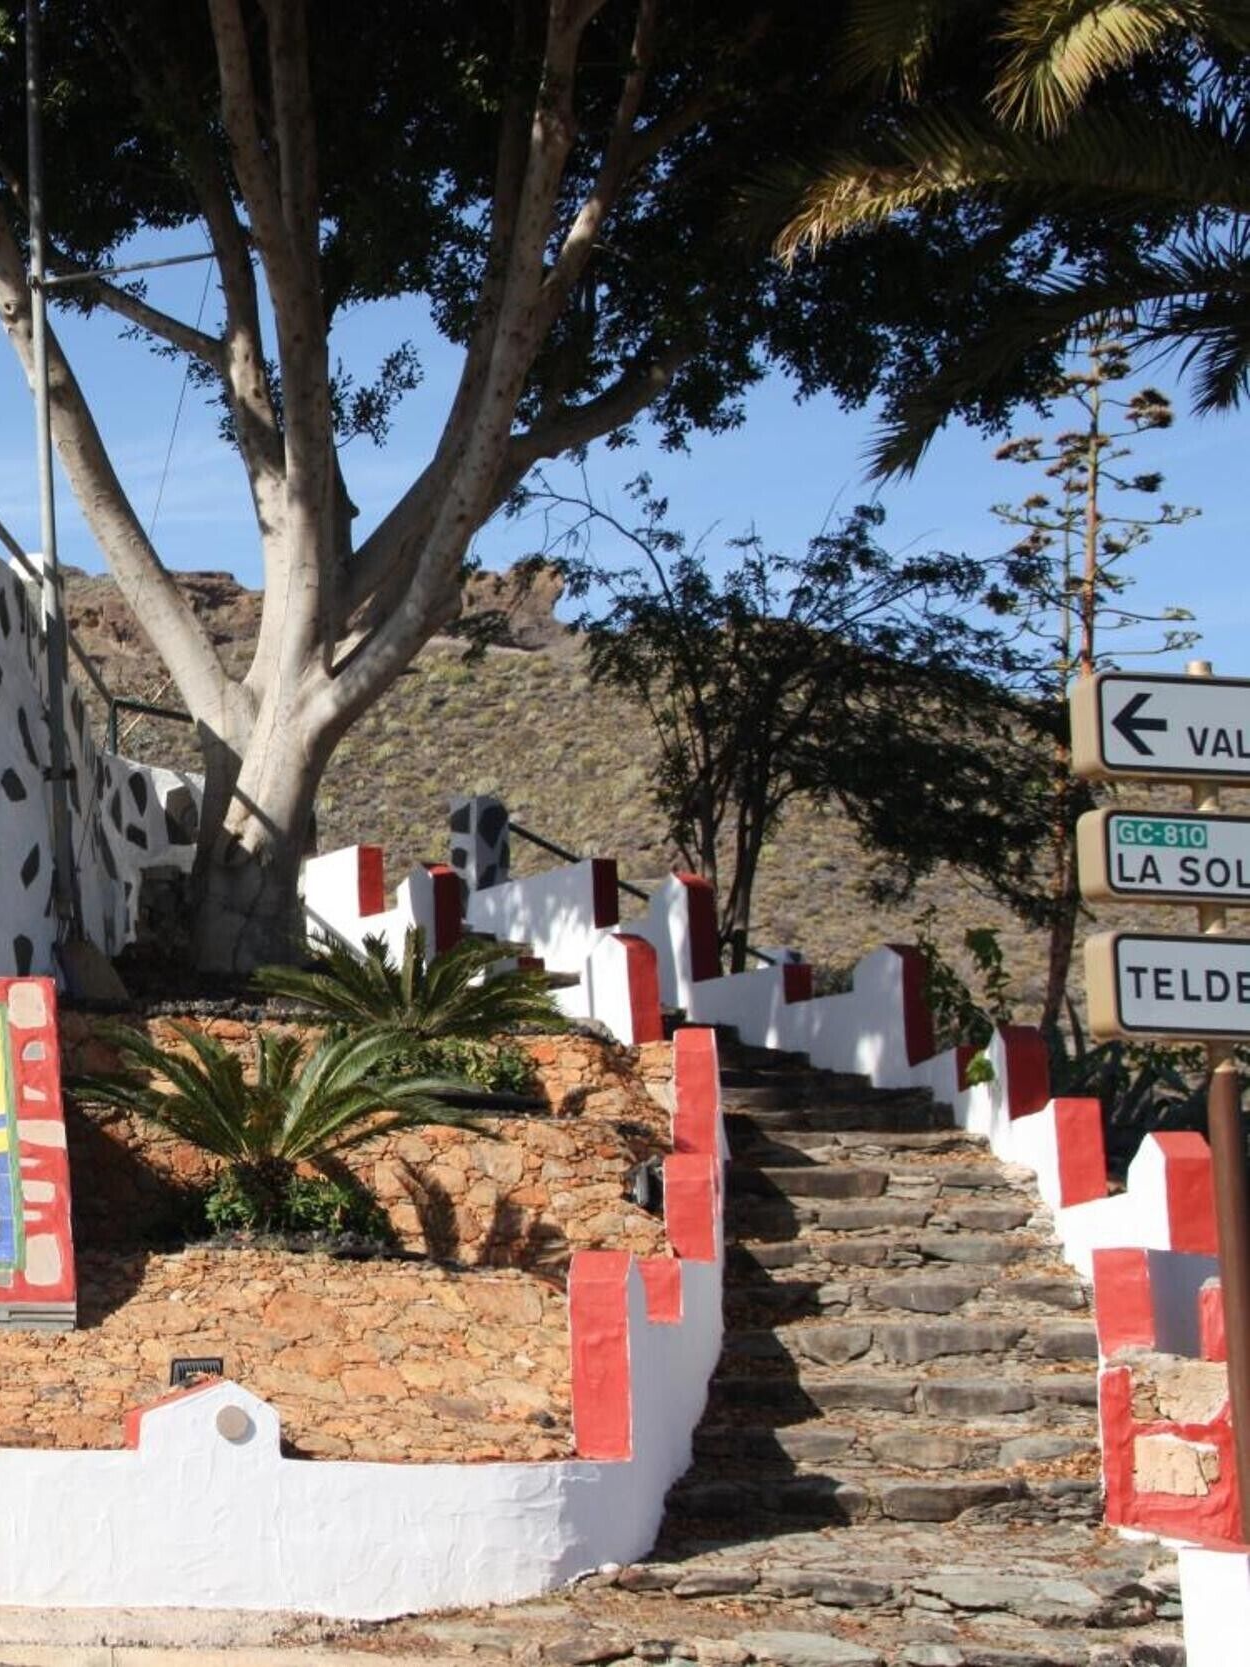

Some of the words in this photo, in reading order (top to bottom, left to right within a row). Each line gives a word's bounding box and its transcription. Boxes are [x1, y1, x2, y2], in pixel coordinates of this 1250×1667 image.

[1187, 726, 1250, 759] VAL
[1119, 822, 1206, 847] GC-810
[1117, 853, 1162, 884] LA
[1179, 856, 1250, 888] SOL
[1126, 966, 1250, 1004] TELDE
